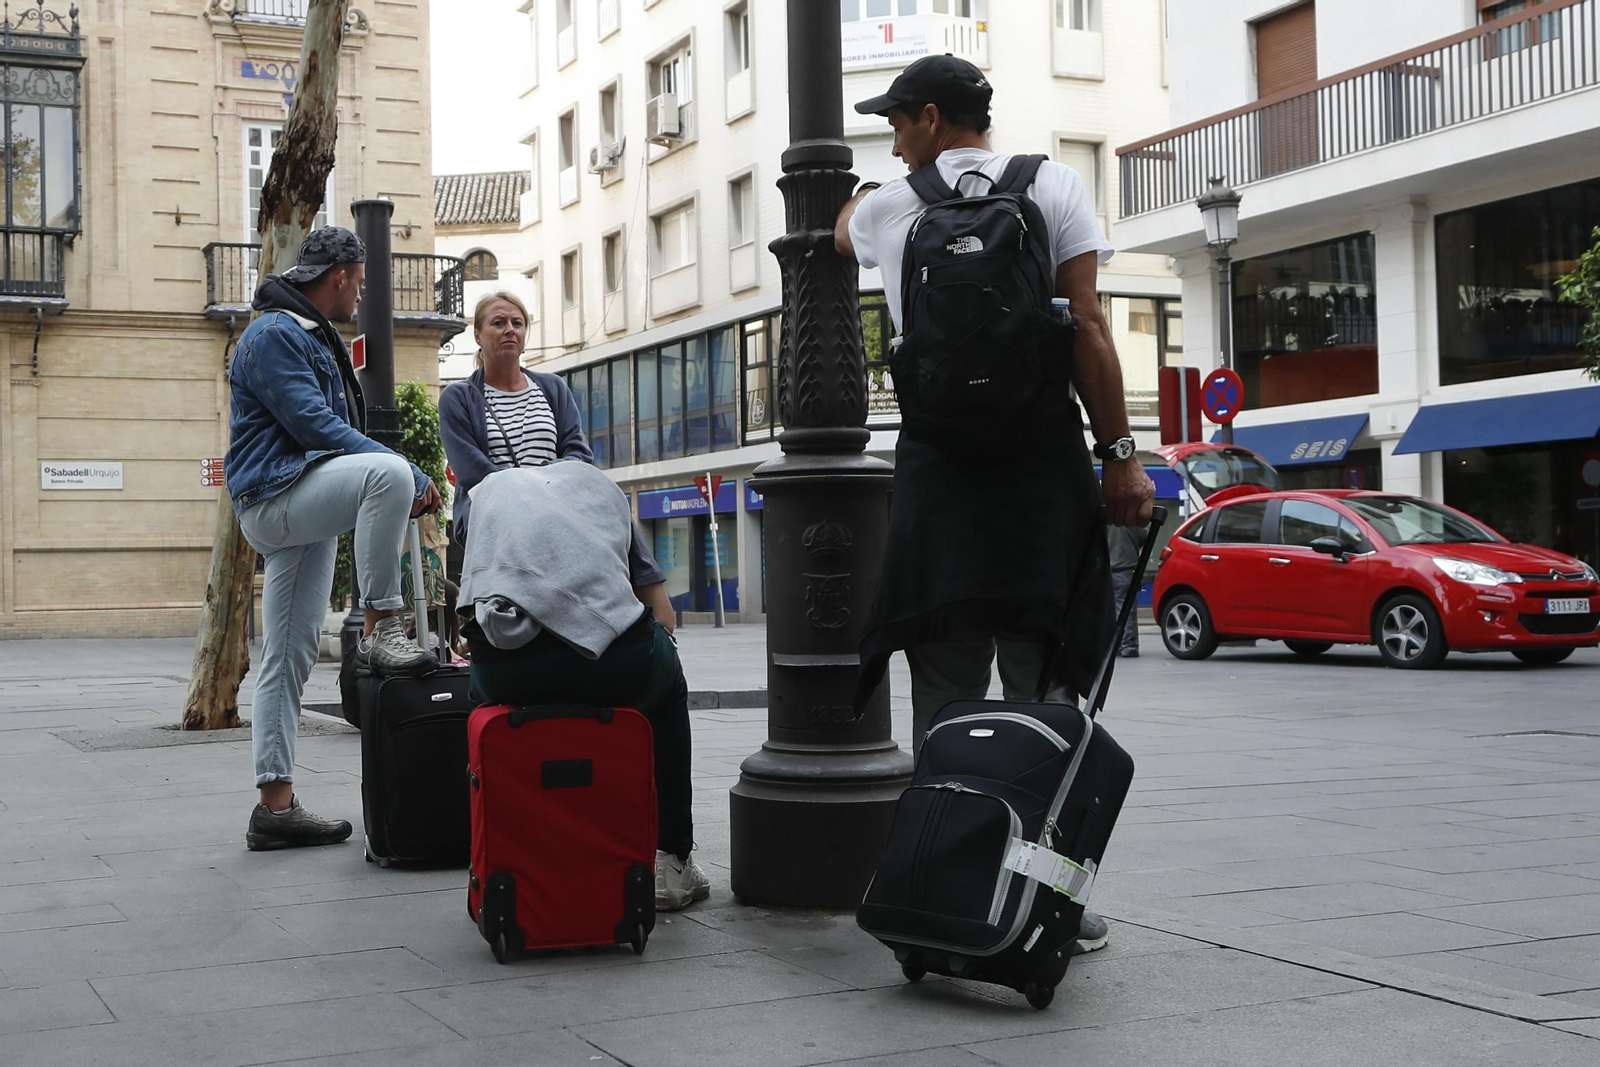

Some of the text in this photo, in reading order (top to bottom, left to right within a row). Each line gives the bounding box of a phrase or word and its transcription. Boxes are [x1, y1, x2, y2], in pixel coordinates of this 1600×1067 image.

[841, 48, 929, 62] SORES INMOBILIARIOS
[946, 242, 971, 251] NORTH
[953, 247, 972, 255] FACE
[672, 357, 708, 391] SOY
[1291, 438, 1347, 460] SEIS
[1550, 600, 1572, 612] 3111
